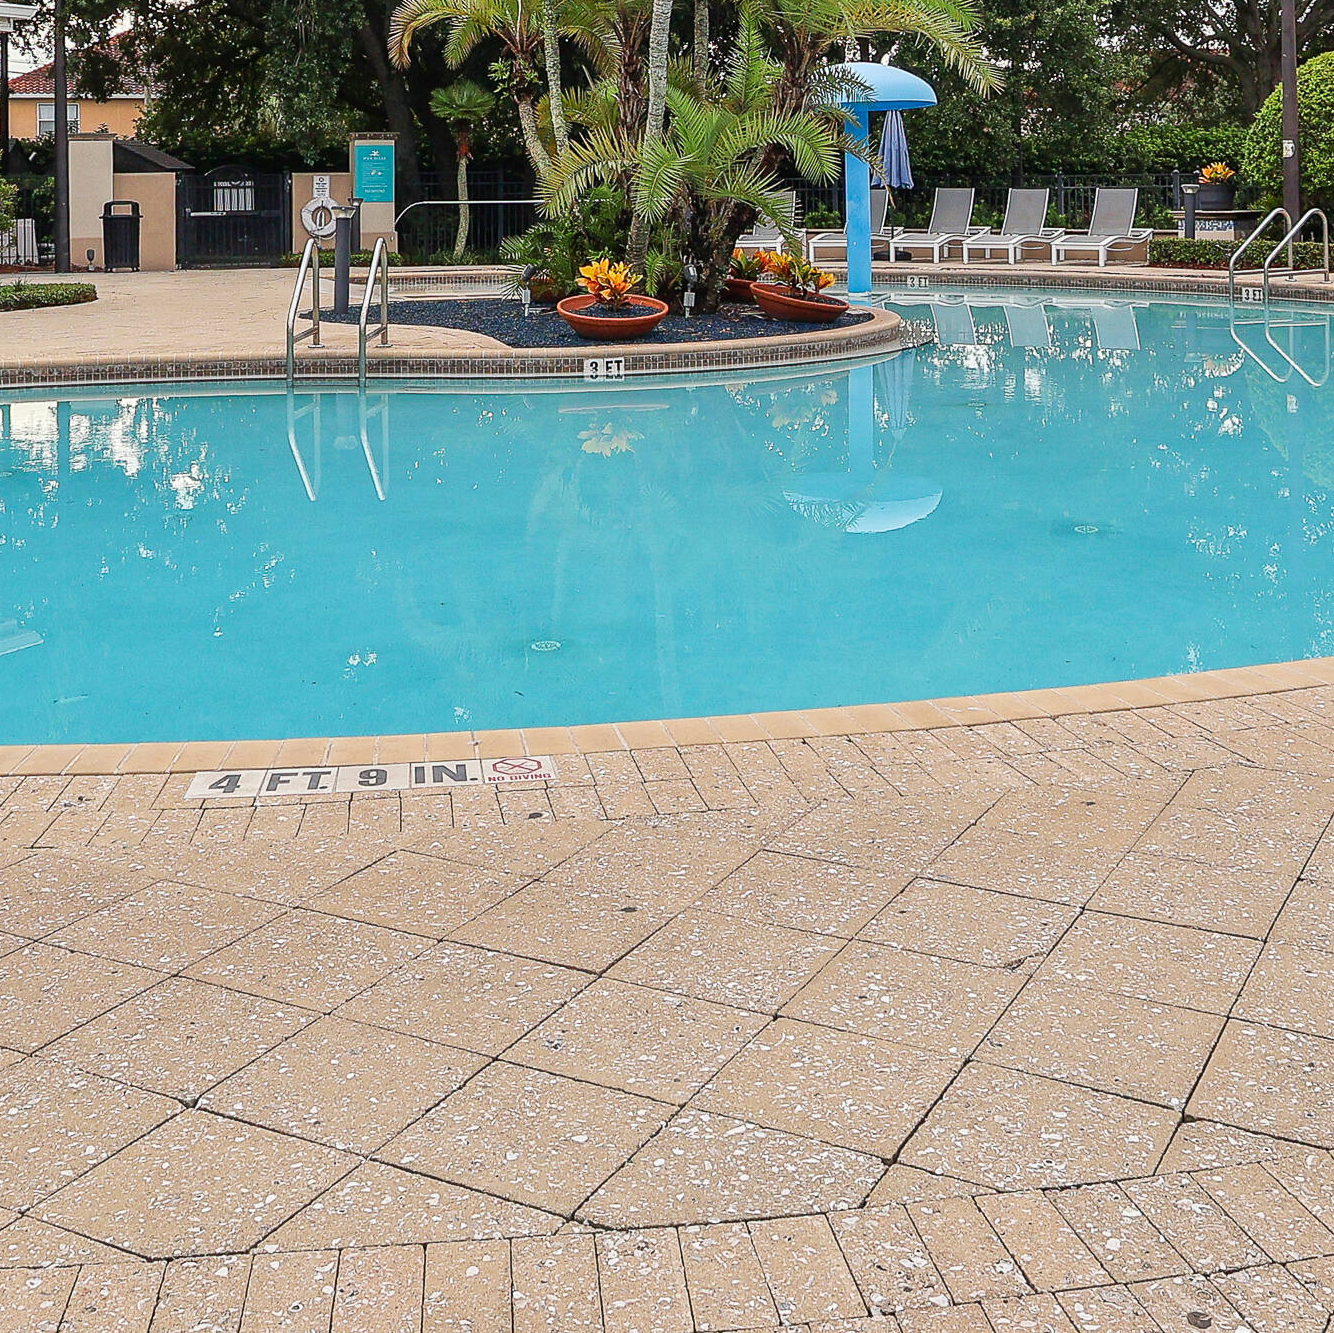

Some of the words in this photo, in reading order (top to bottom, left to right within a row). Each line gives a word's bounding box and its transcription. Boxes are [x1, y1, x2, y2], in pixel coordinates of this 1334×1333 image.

[909, 276, 916, 288] 3
[1244, 288, 1250, 301] 3
[589, 360, 599, 379] 3
[208, 774, 241, 794] 4
[266, 770, 332, 792] FT.
[358, 768, 387, 787] 9
[414, 764, 478, 784] IN.
[509, 773, 552, 781] DIVING
